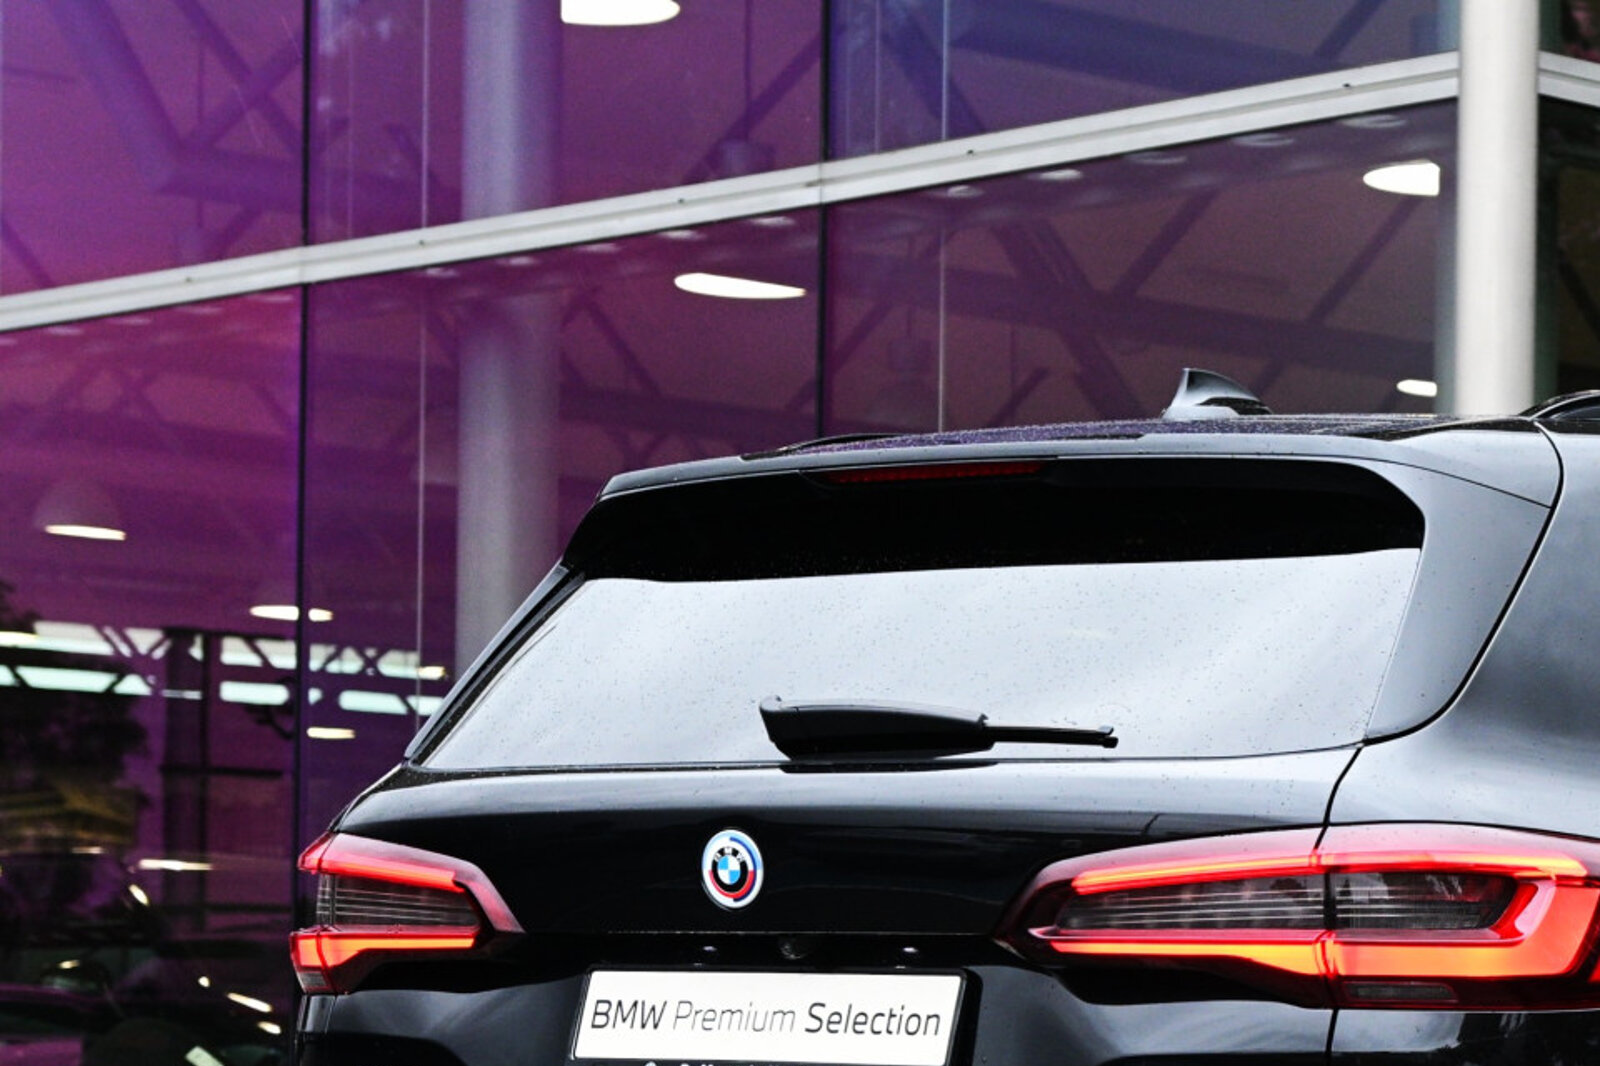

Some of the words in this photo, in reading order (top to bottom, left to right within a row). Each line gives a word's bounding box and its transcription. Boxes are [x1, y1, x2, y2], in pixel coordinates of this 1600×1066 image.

[591, 1000, 667, 1030] BMW
[672, 1000, 796, 1033] Premium
[804, 1002, 942, 1036] Selection
